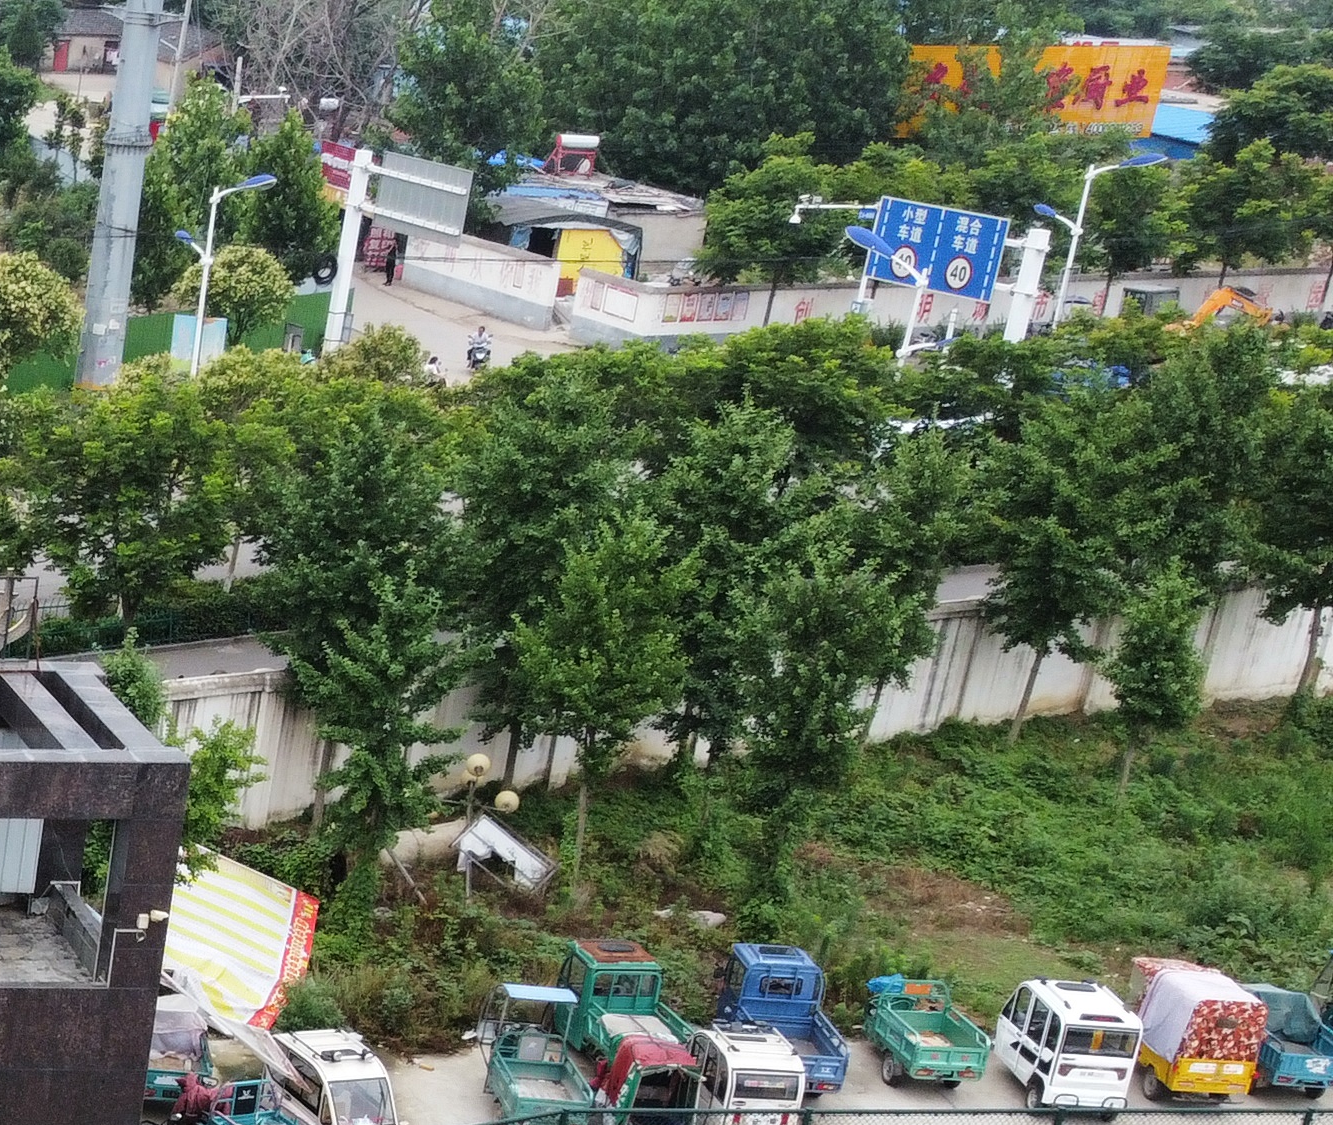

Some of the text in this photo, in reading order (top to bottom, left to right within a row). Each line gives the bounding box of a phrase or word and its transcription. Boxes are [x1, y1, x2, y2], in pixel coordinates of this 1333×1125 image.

[901, 205, 929, 226] 小型
[955, 215, 983, 236] 混合
[896, 223, 924, 244] 车道
[951, 234, 979, 255] 车道
[950, 264, 968, 283] 40
